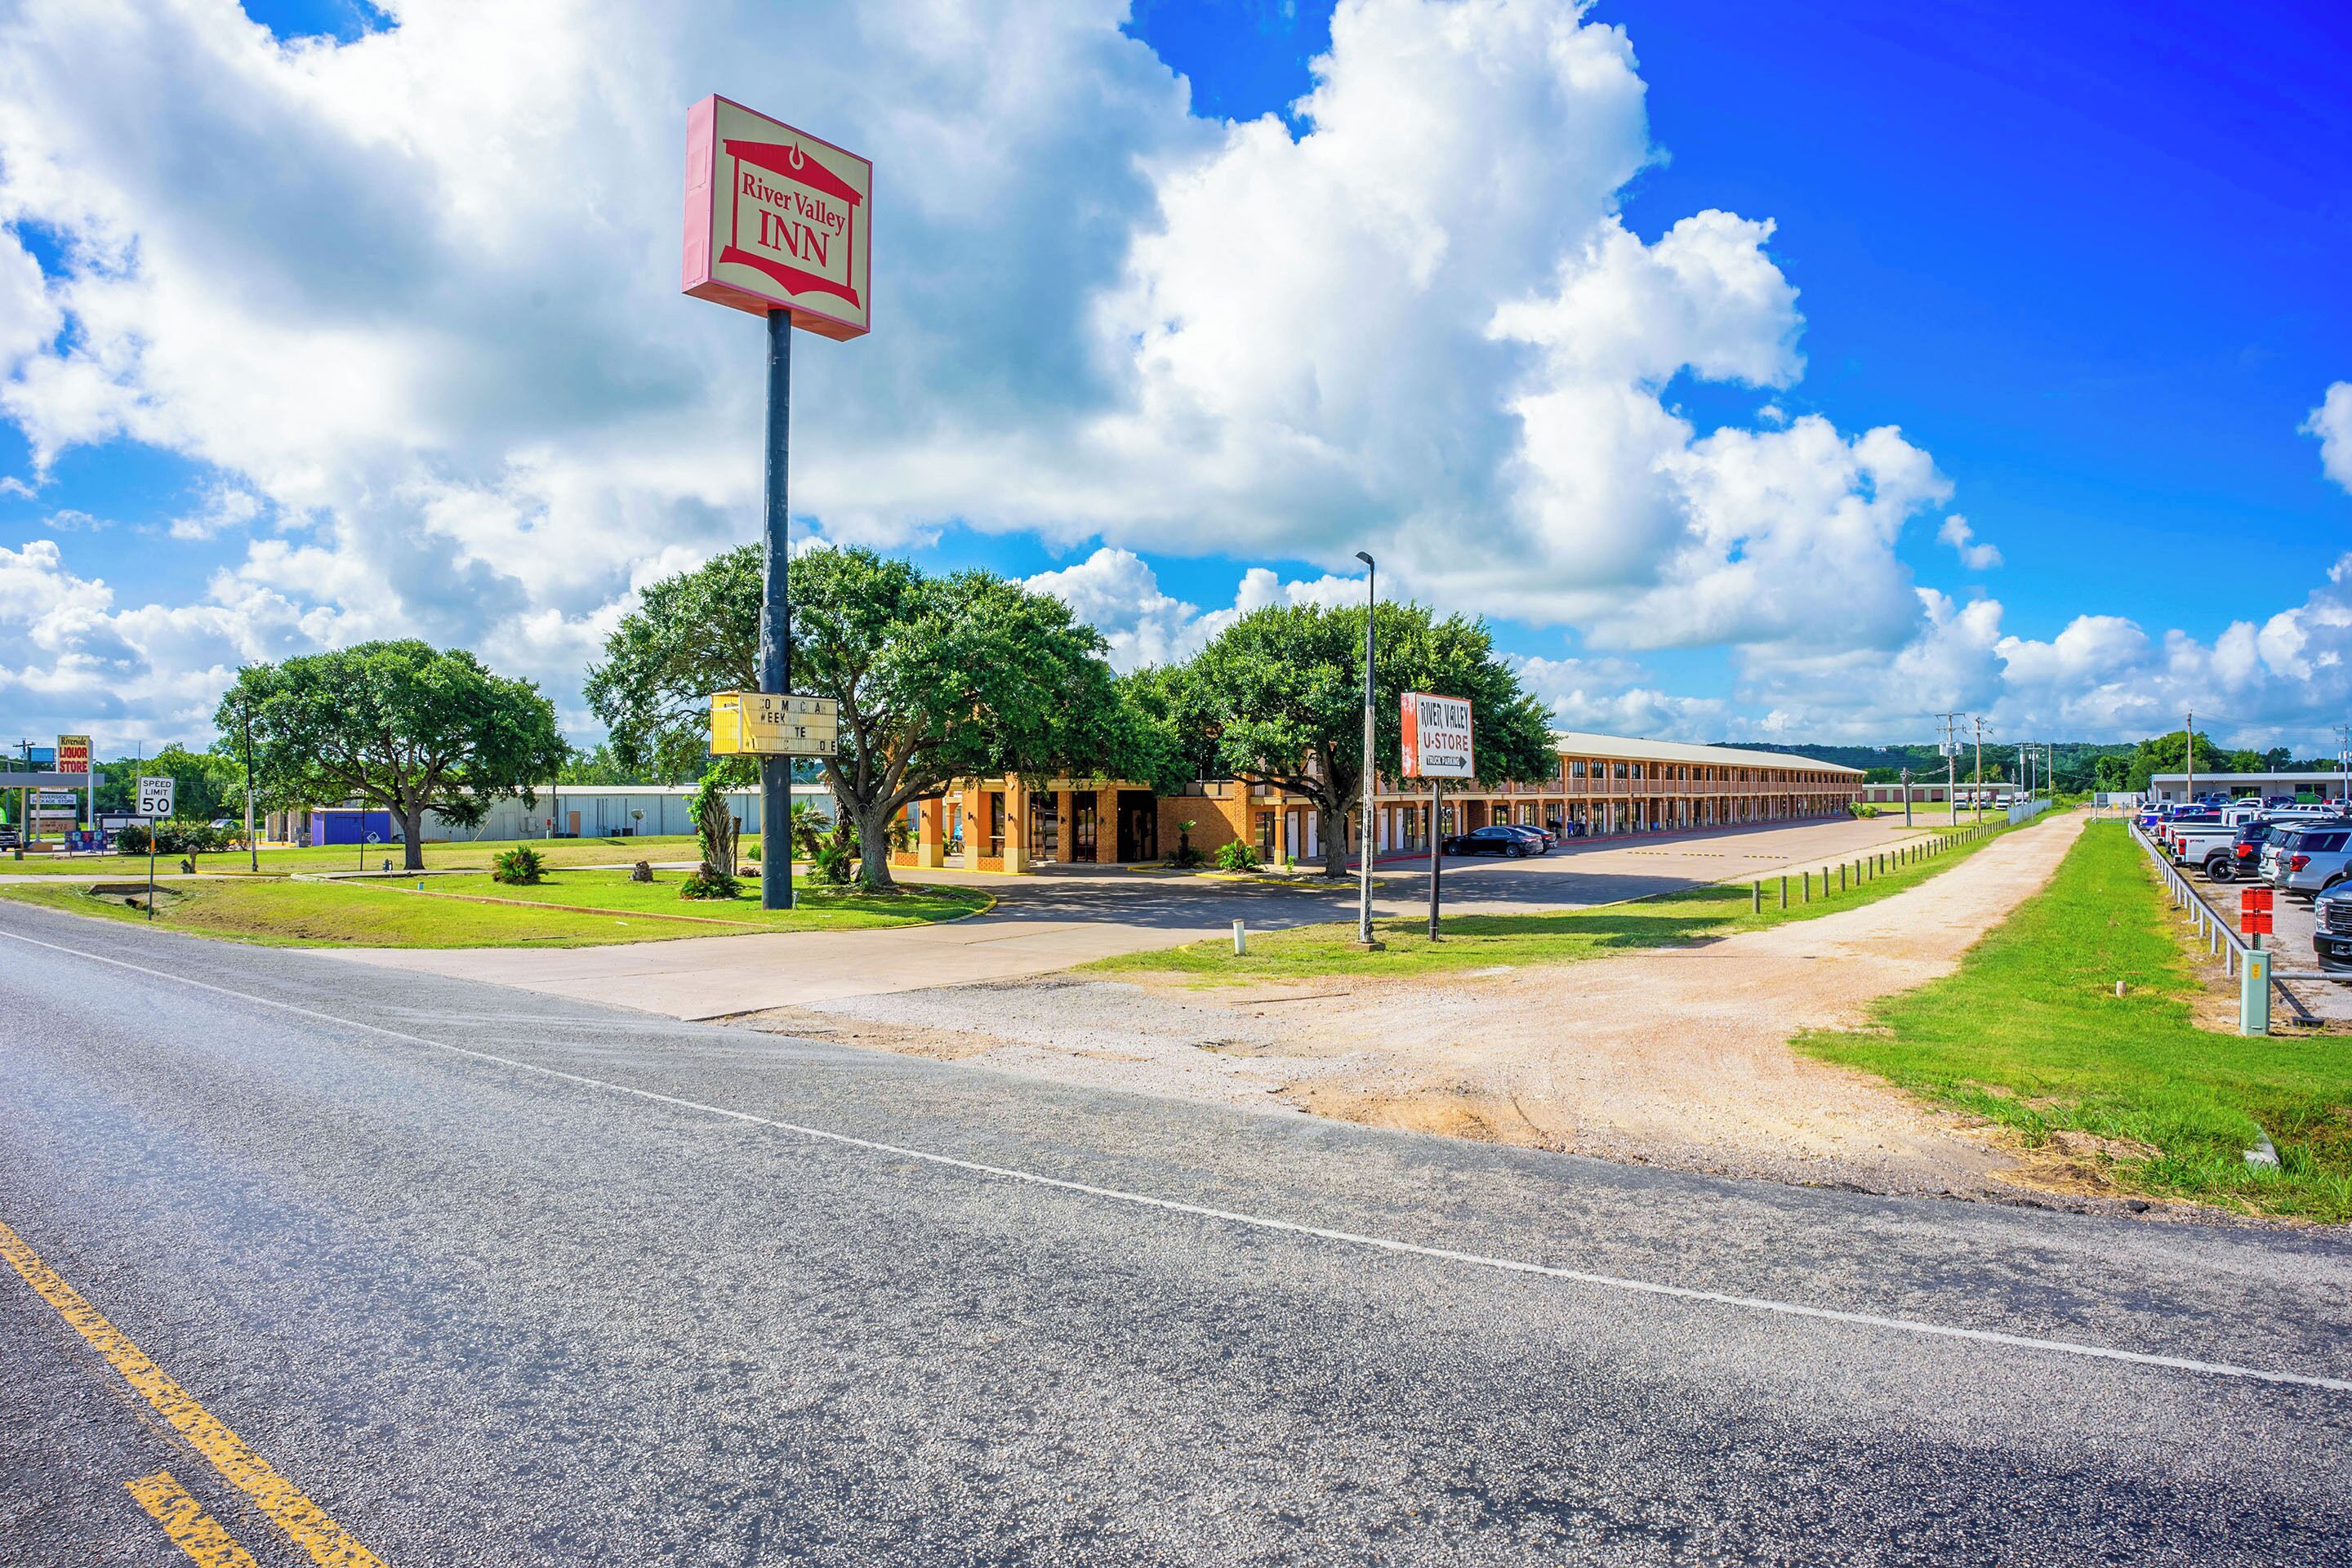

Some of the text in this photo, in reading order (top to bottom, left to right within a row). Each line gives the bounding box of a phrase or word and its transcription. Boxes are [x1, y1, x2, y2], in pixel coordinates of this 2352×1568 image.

[742, 172, 845, 236] River Valley
[757, 208, 830, 268] INN
[1421, 702, 1468, 732] RIVER VALLEY
[61, 737, 86, 745] Riverside
[1423, 732, 1468, 751] U-STORE
[60, 747, 87, 758] LIQUOR
[60, 760, 87, 773] STORE
[143, 780, 171, 788] SPEED
[142, 797, 169, 812] 50
